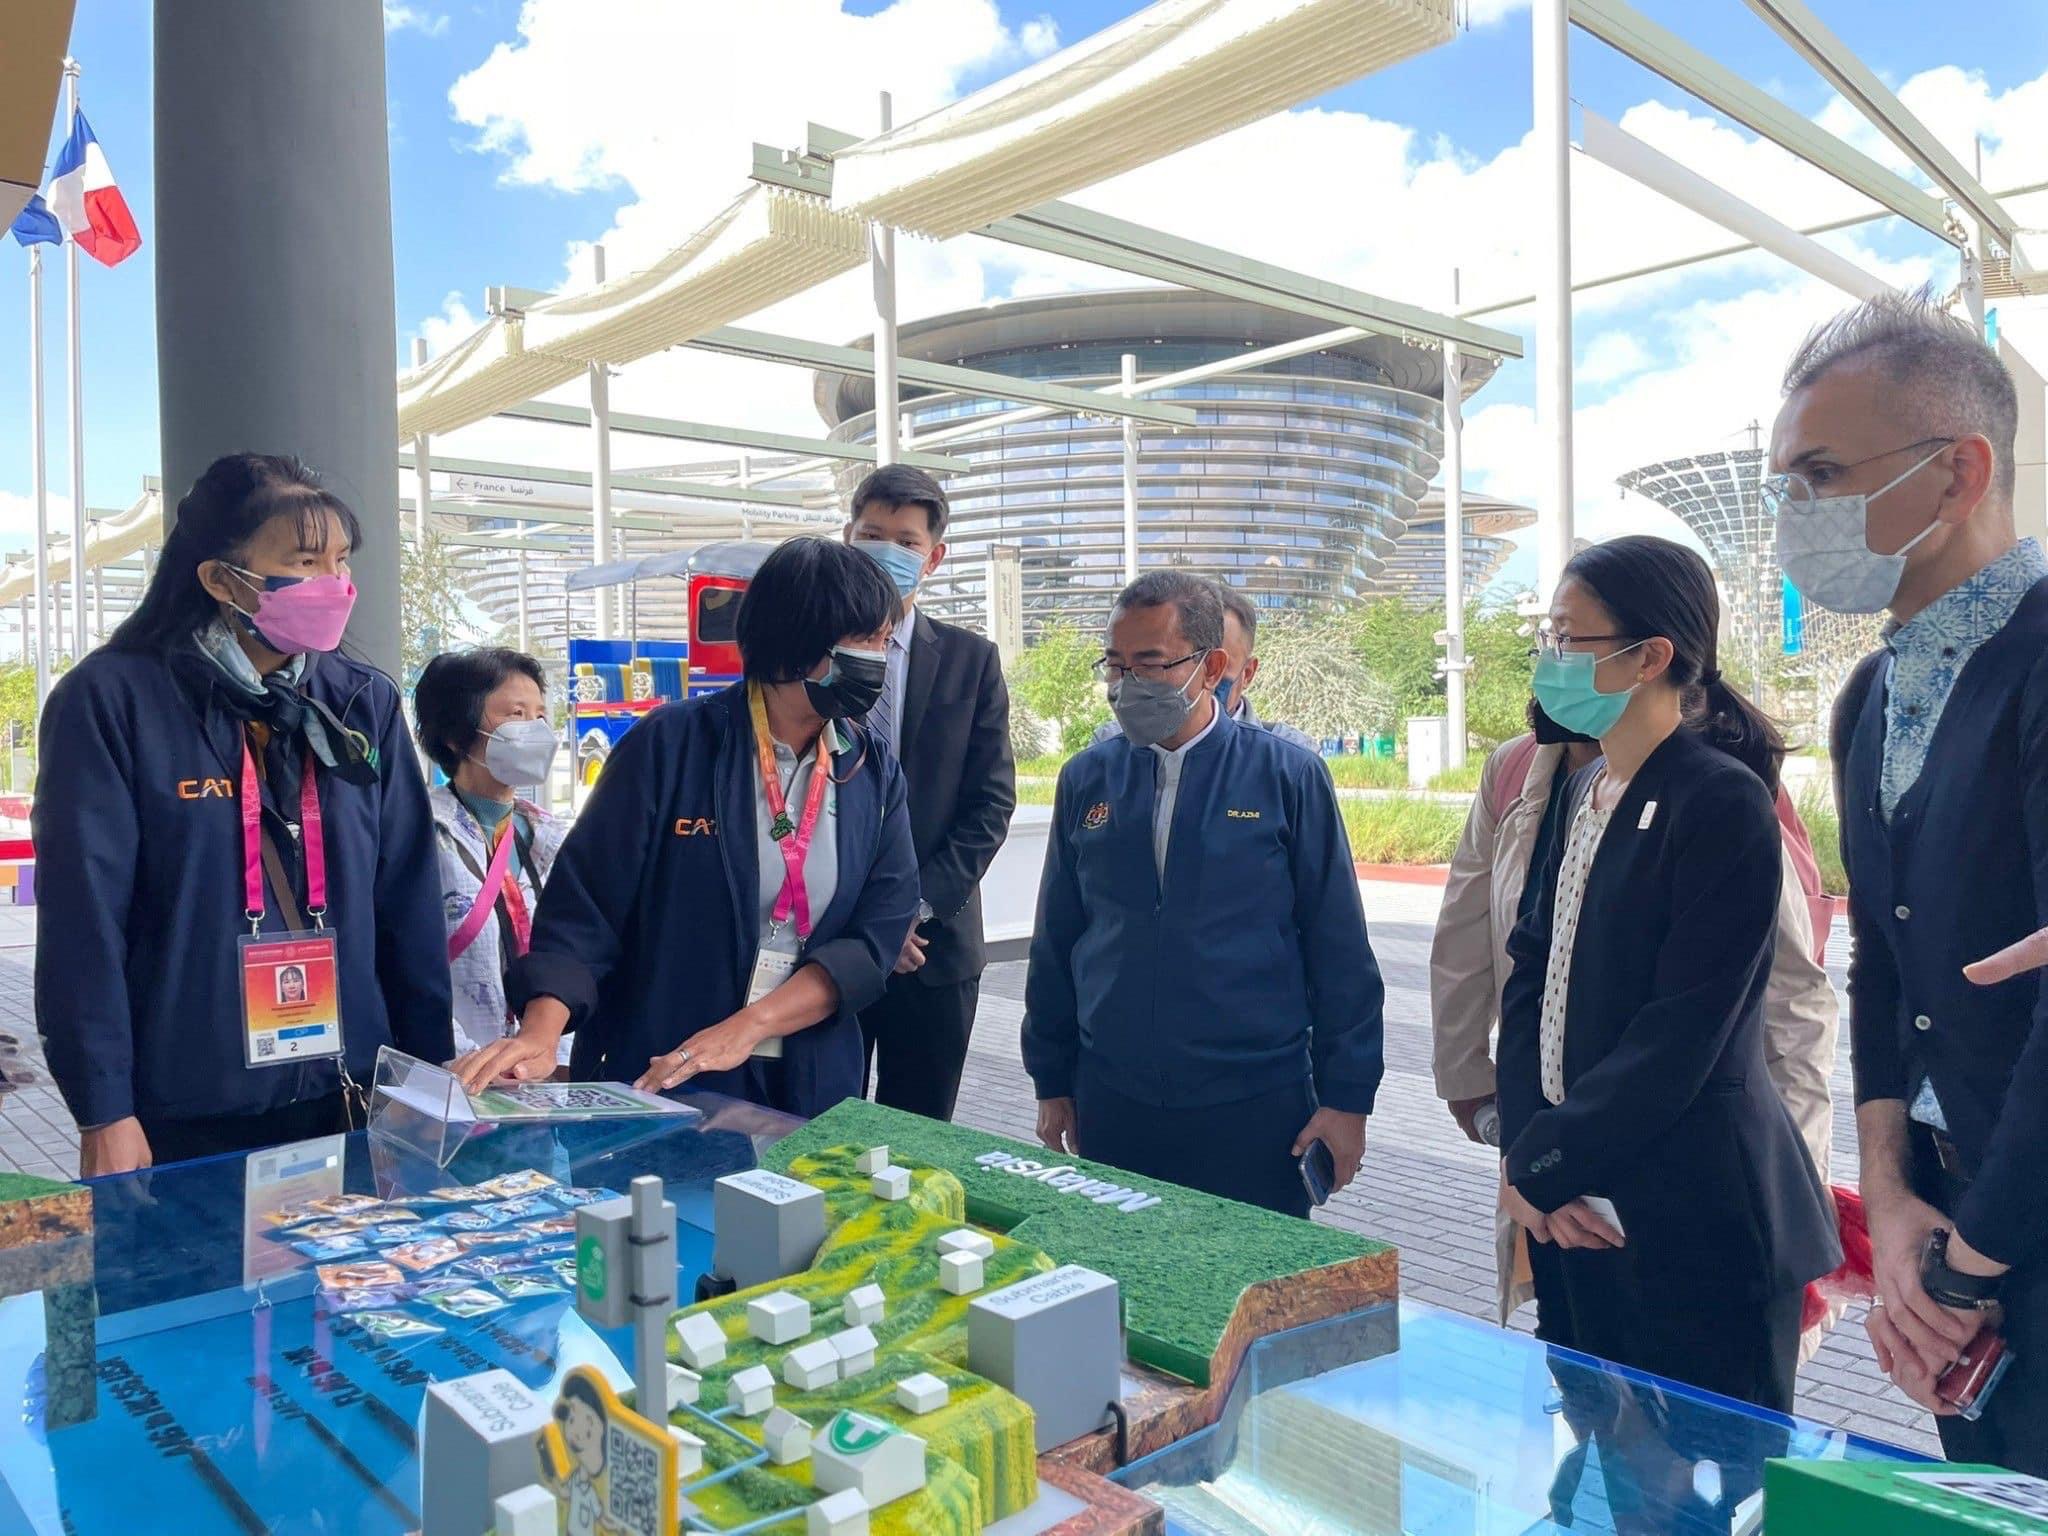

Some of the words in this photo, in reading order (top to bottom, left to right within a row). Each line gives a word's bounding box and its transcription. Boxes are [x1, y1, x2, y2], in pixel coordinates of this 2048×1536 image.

[473, 480, 506, 493] France
[510, 485, 535, 497] فرنسا
[772, 509, 800, 522] Parking
[290, 1042, 298, 1052] 2
[974, 1150, 1163, 1213] Malaysia
[989, 1268, 1087, 1306] Submarine
[1029, 1281, 1086, 1304] Cable
